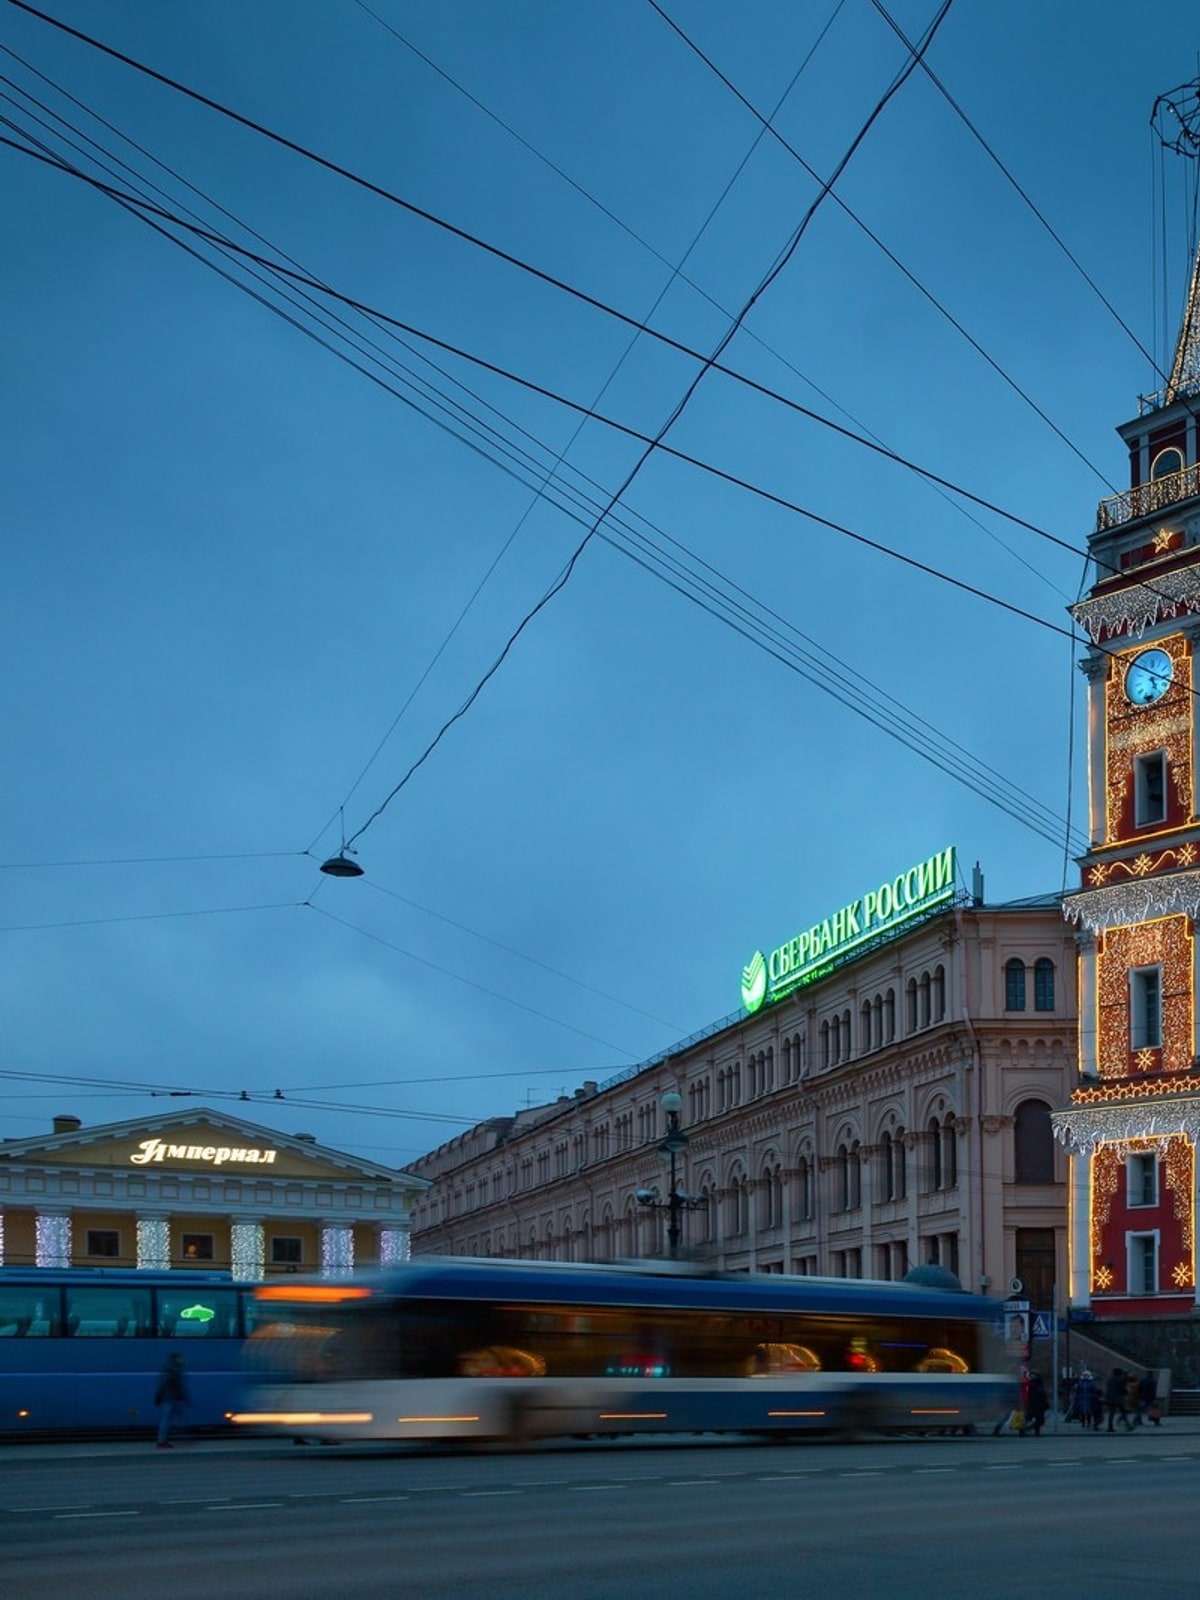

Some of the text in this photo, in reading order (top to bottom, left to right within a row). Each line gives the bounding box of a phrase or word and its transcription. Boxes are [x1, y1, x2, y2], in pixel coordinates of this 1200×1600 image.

[769, 846, 955, 981] СБЕРБАНК РОССИИ
[130, 1138, 278, 1165] Империал
